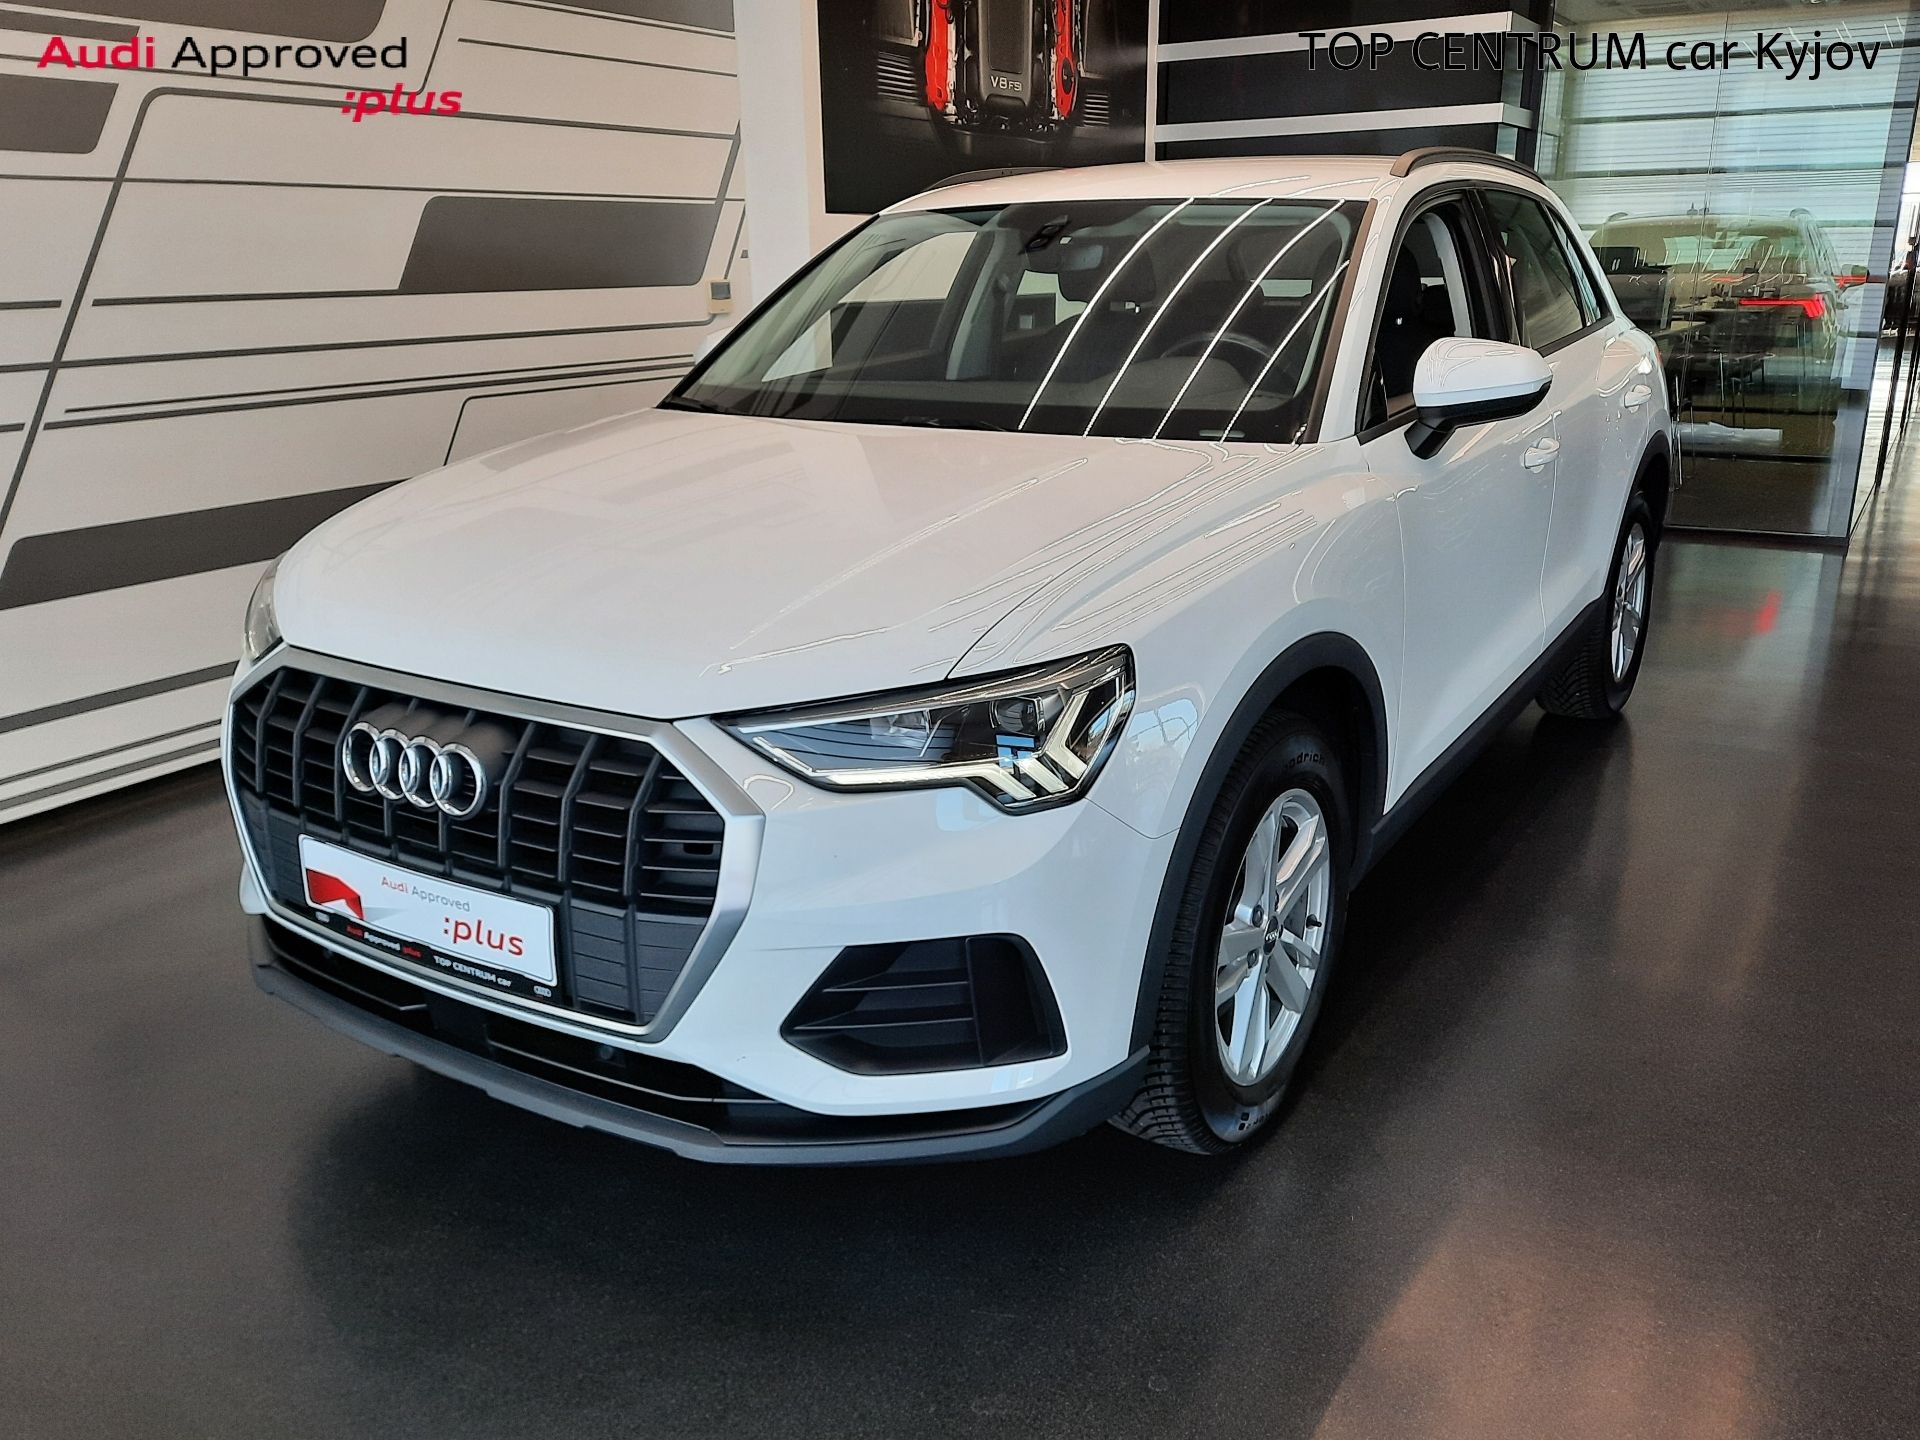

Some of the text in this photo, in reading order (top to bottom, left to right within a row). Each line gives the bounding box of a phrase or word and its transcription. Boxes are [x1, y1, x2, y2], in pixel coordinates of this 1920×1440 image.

[381, 876, 471, 913] Audi Approved
[444, 917, 525, 957] :plus
[433, 955, 452, 967] TOP
[453, 961, 497, 982] CENTRUM
